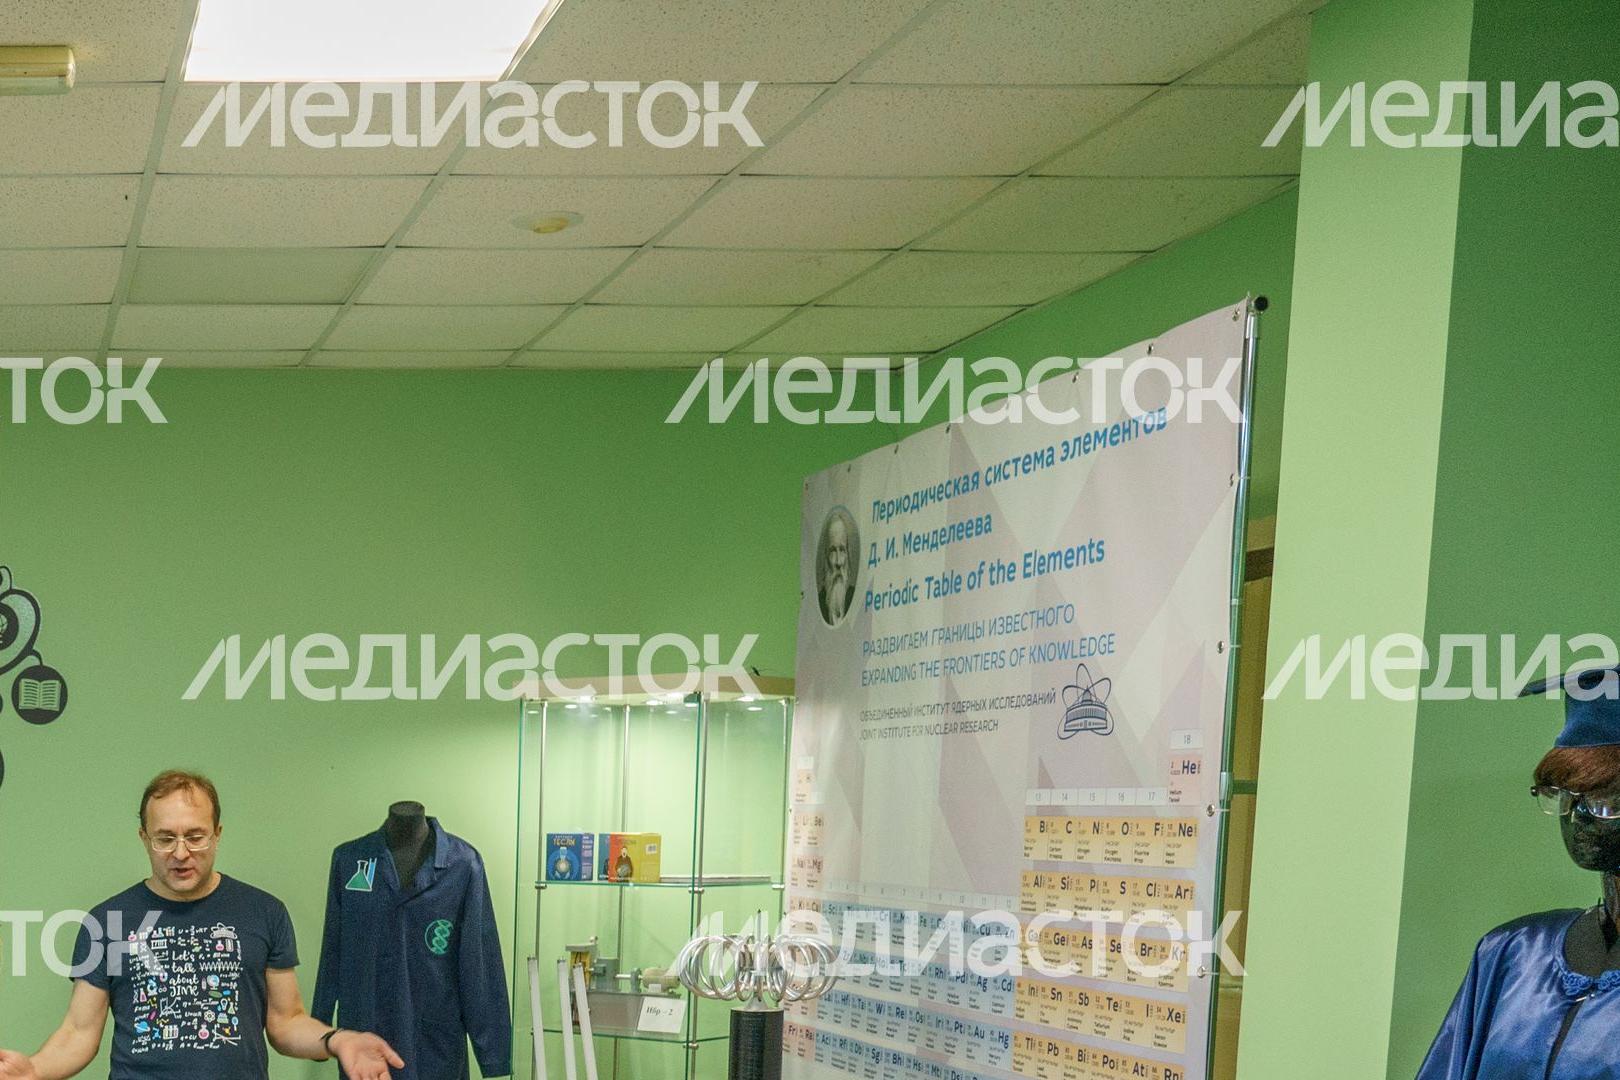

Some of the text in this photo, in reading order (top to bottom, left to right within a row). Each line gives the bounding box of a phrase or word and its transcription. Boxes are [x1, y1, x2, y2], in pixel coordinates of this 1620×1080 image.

[872, 407, 1167, 523] Периодическая система элементов
[868, 514, 992, 569] Д. И. Менделеева
[865, 538, 1105, 612] Periodic Table of the Elements
[863, 603, 1074, 658] РАЗДВИГАЕМ ГРАНИЦЫ ИЗВЕСТНОГО
[862, 634, 1115, 687] EXPANDING THE FRONTIERS OF KNOWLEDGE
[952, 696, 986, 715] ЯДЕРНЫХ
[989, 688, 1056, 710] ИССЛЕДОВАНИЙ
[925, 721, 958, 736] NUCLEAR
[960, 719, 998, 734] RESEARCH
[1183, 735, 1191, 744] 18
[1182, 760, 1196, 774] He
[1178, 823, 1193, 837] Ne
[1175, 886, 1189, 899] Ar
[172, 951, 194, 961] Let's
[172, 962, 196, 973] talk
[169, 974, 199, 986] about
[1051, 988, 1062, 1001] Sn
[1078, 992, 1089, 1006] Sb
[1107, 997, 1118, 1012] Te
[1166, 1008, 1180, 1023] Xe
[1047, 1043, 1059, 1057] Pb
[1102, 1055, 1115, 1069] Po
[1132, 1062, 1145, 1077] At
